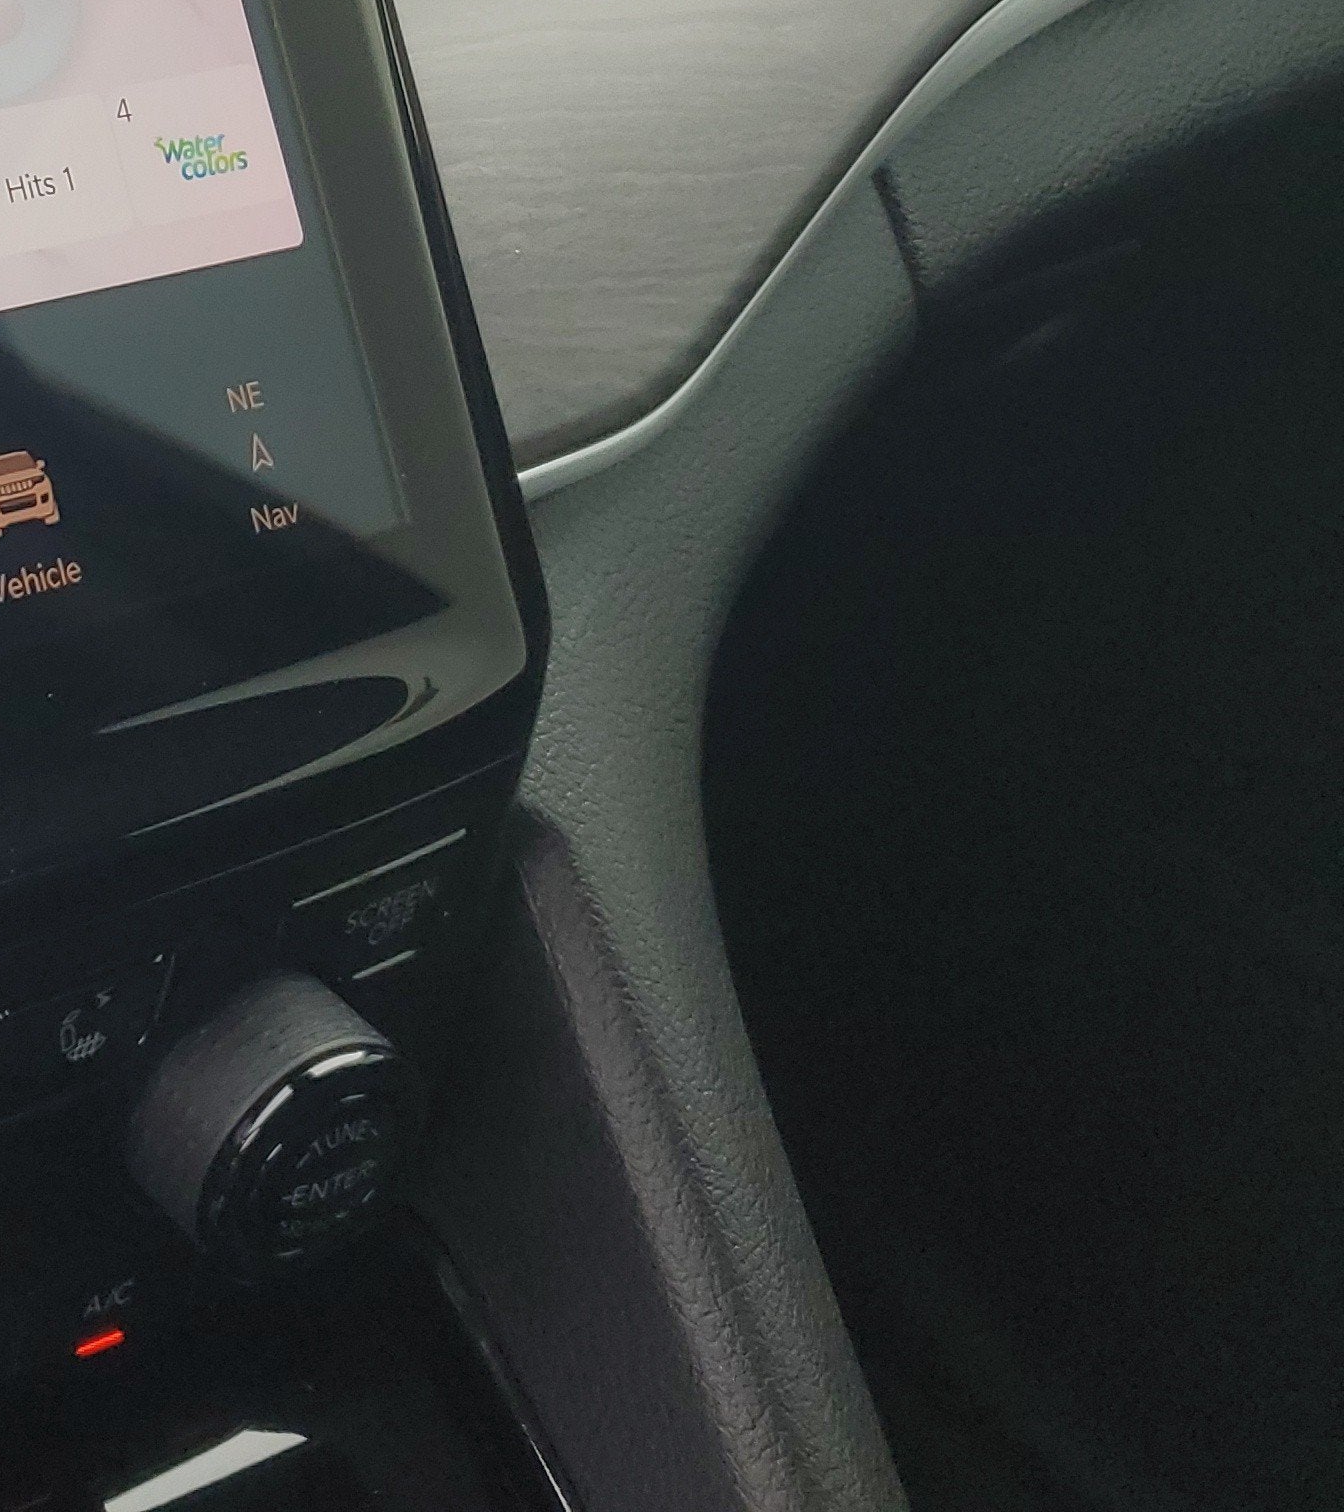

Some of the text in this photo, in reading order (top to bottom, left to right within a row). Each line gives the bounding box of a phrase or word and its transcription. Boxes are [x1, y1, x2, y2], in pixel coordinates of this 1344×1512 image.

[116, 98, 132, 122] 4
[181, 150, 249, 181] colors
[5, 166, 75, 204] Hits 1
[227, 381, 264, 412] NE
[250, 502, 298, 534] Nav
[82, 1277, 135, 1319] A/C
